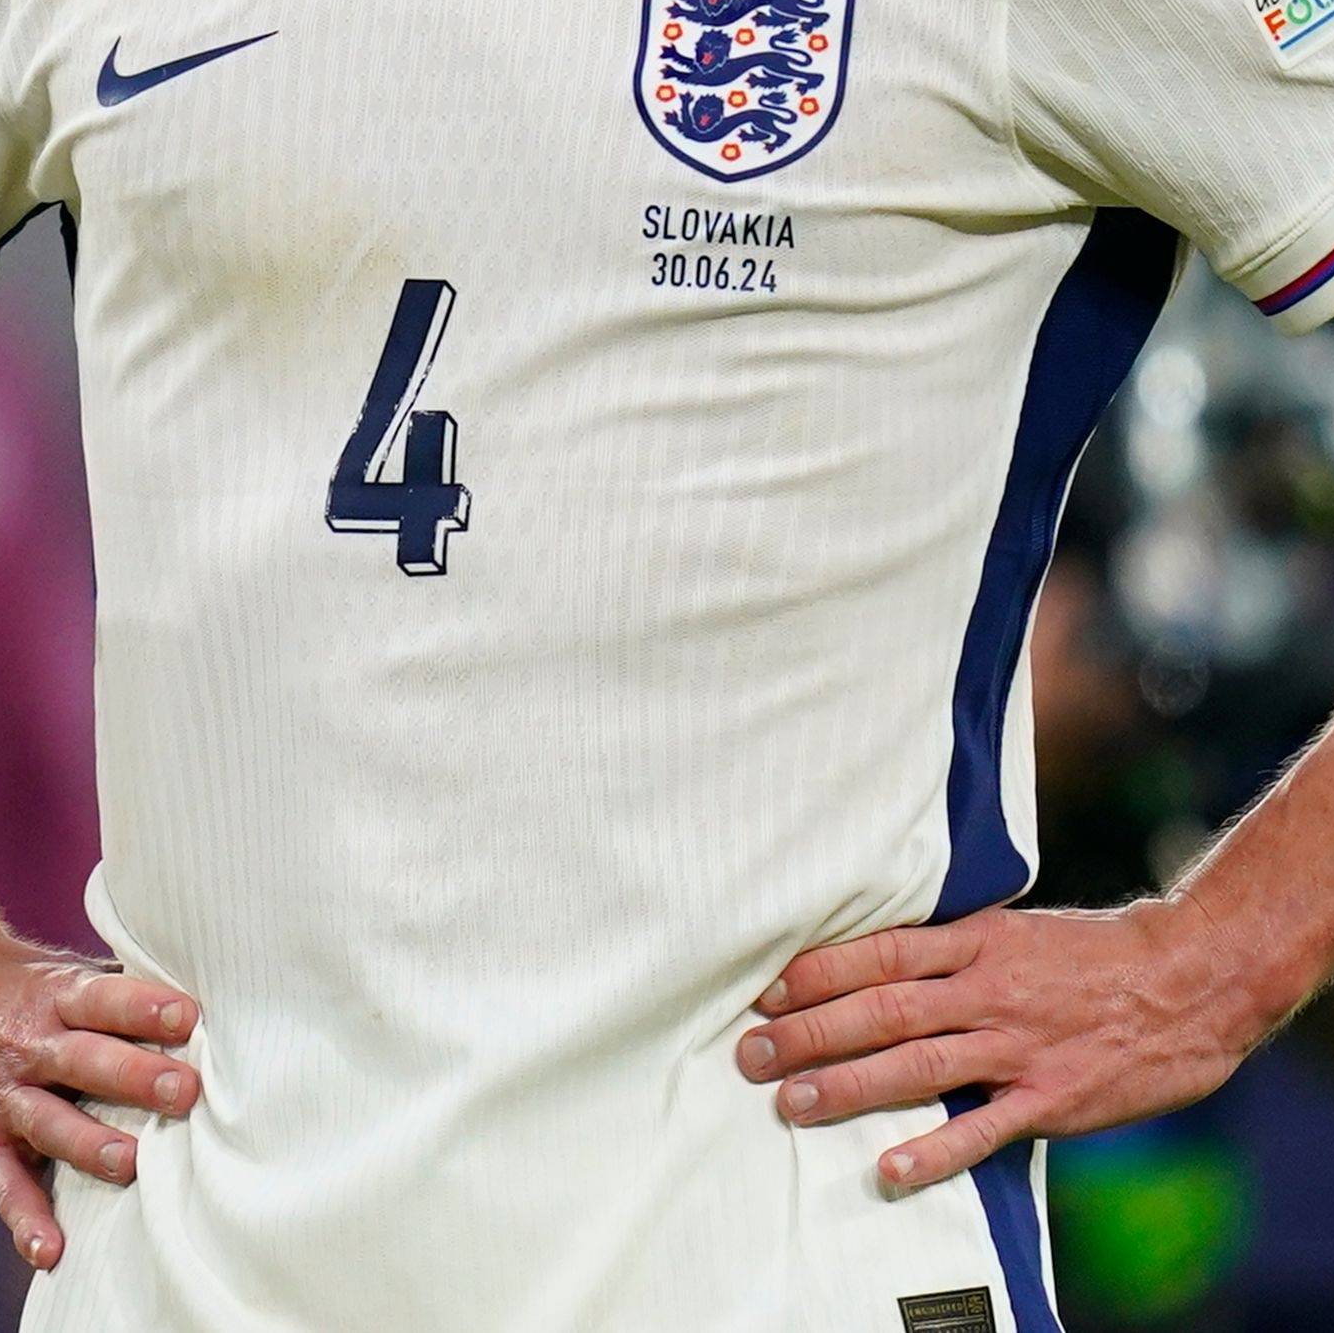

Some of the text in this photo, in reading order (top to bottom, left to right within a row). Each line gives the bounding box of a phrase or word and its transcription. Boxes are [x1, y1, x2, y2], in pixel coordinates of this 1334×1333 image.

[642, 204, 795, 249] SLOVAKIA
[651, 252, 777, 293] 30.06.24
[325, 278, 472, 577] 4
